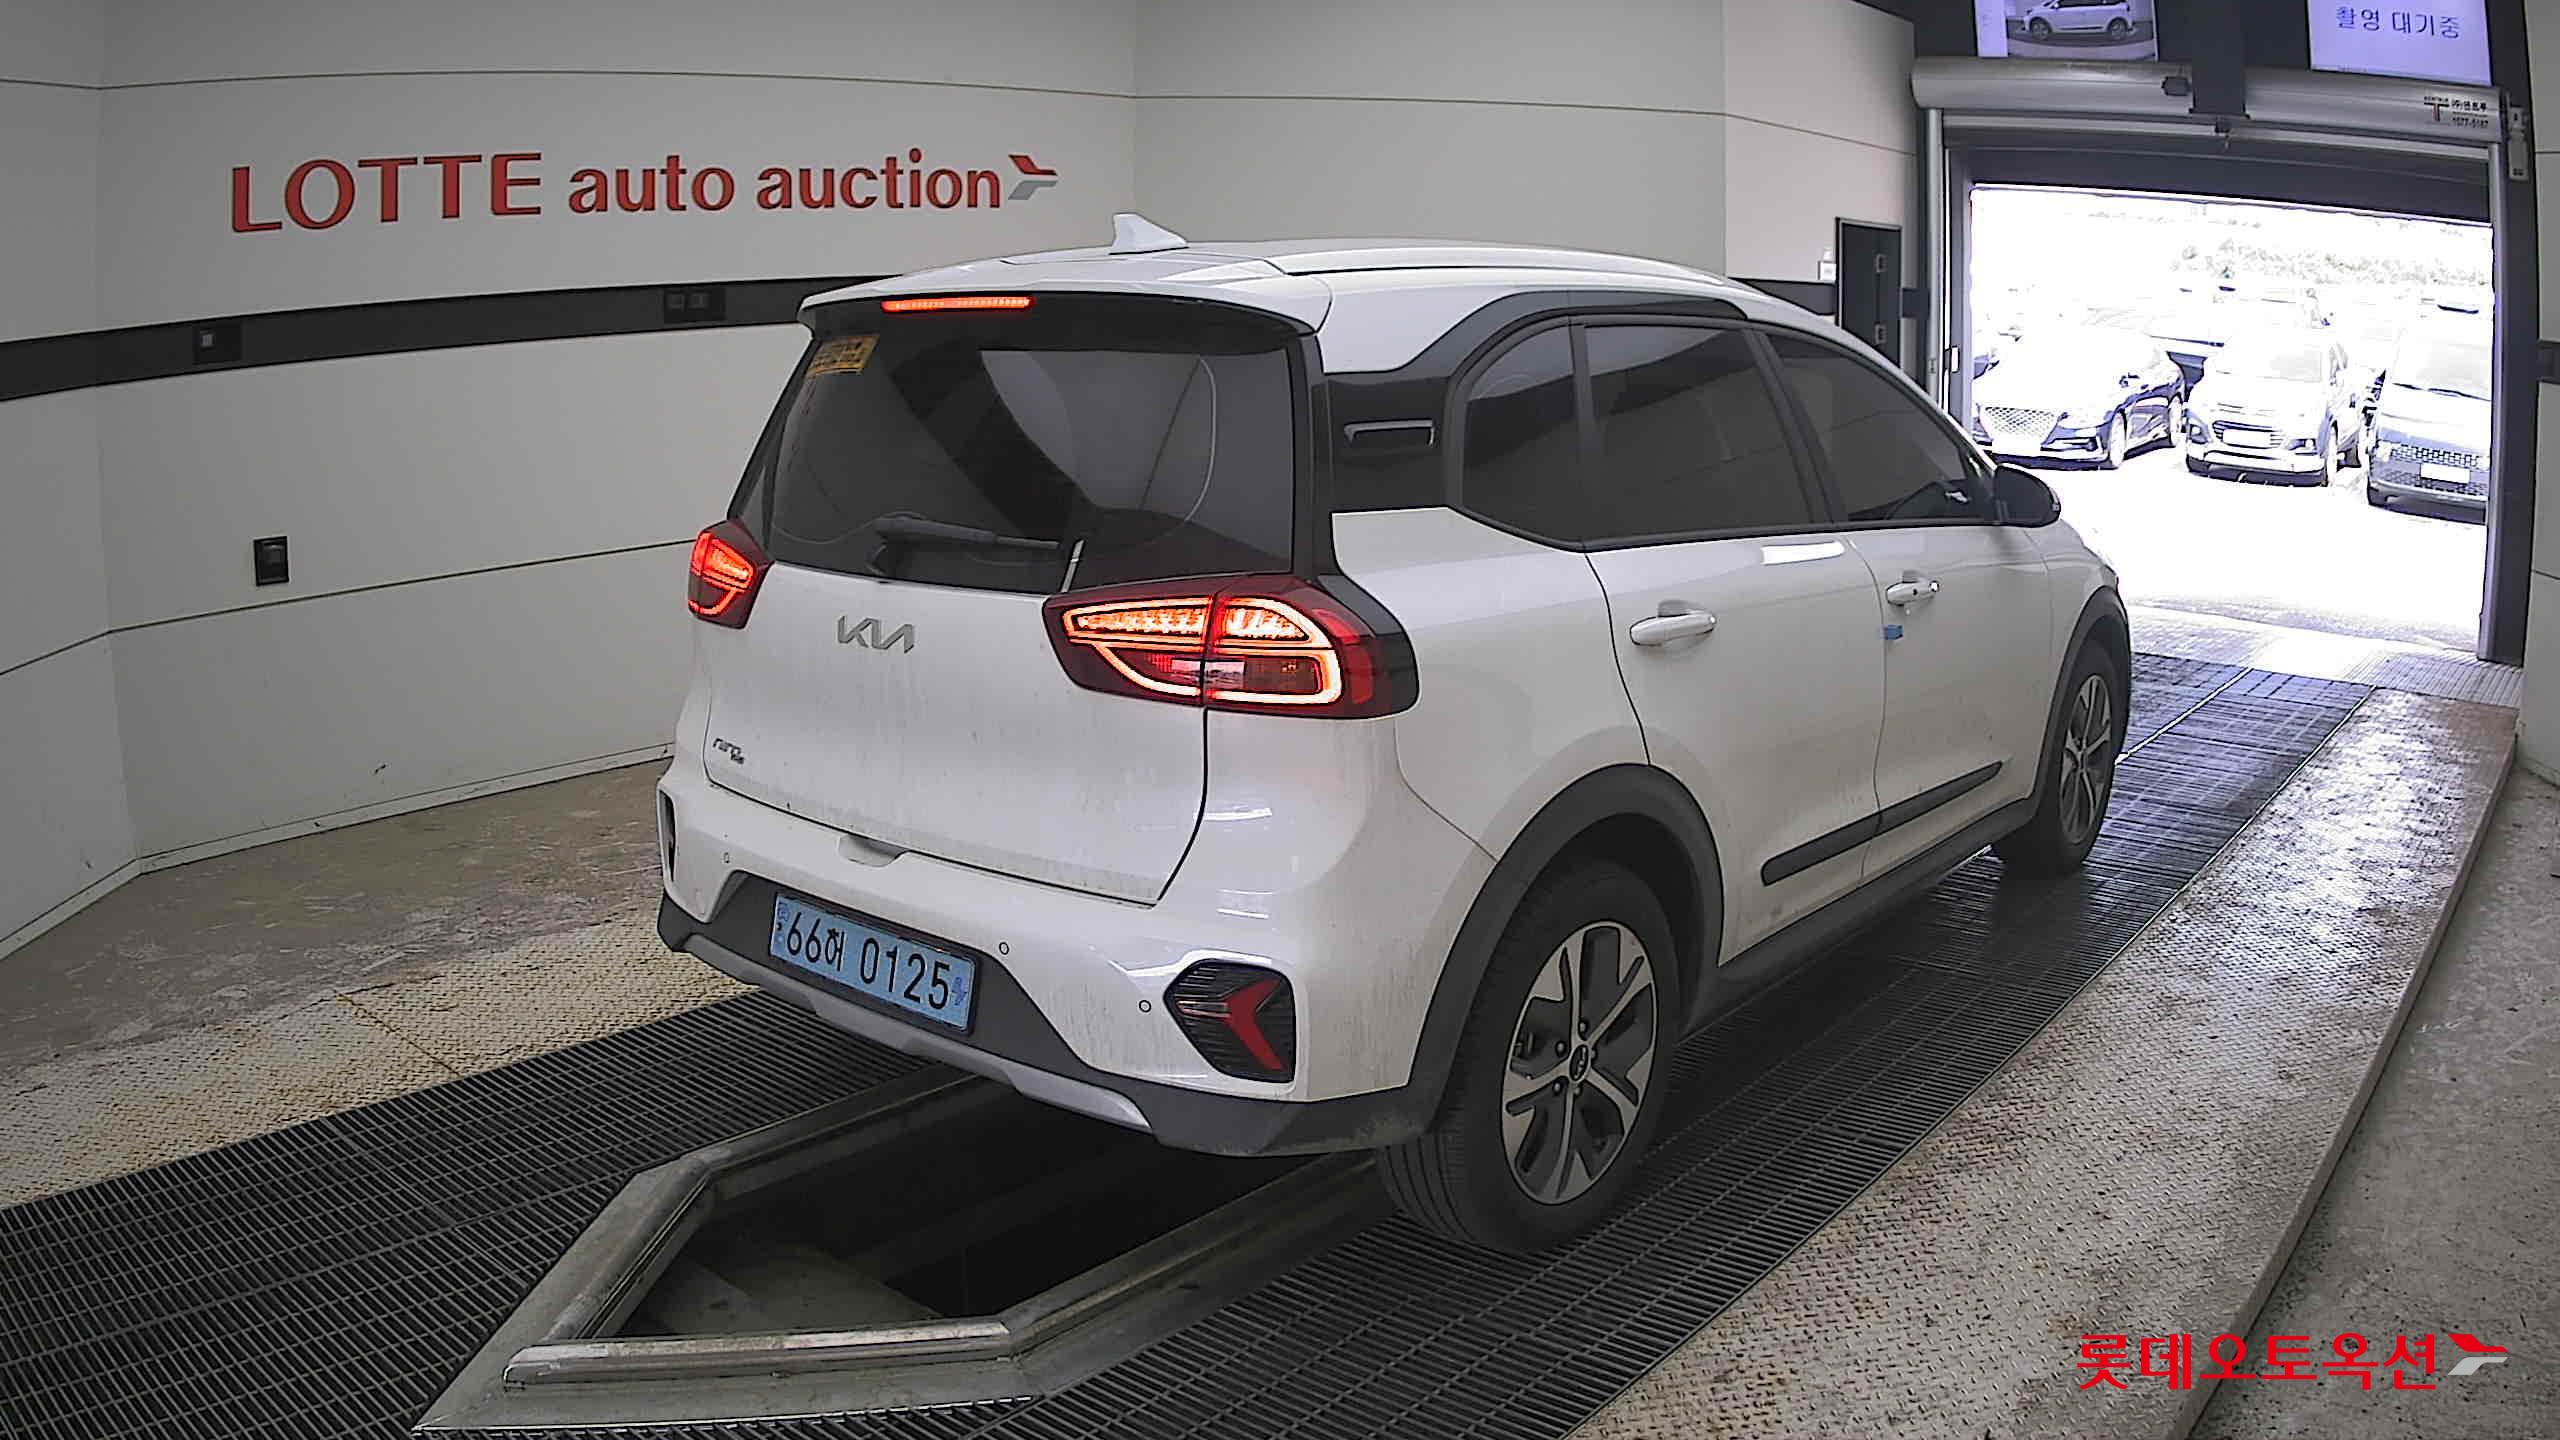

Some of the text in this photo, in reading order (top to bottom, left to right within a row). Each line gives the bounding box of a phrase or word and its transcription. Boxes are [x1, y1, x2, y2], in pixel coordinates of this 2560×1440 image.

[2336, 6, 2460, 39] 촬영 대기중
[232, 148, 1001, 233] LOTTE auto auction
[837, 616, 915, 654] KIA
[786, 911, 951, 1010] 66허 0125
